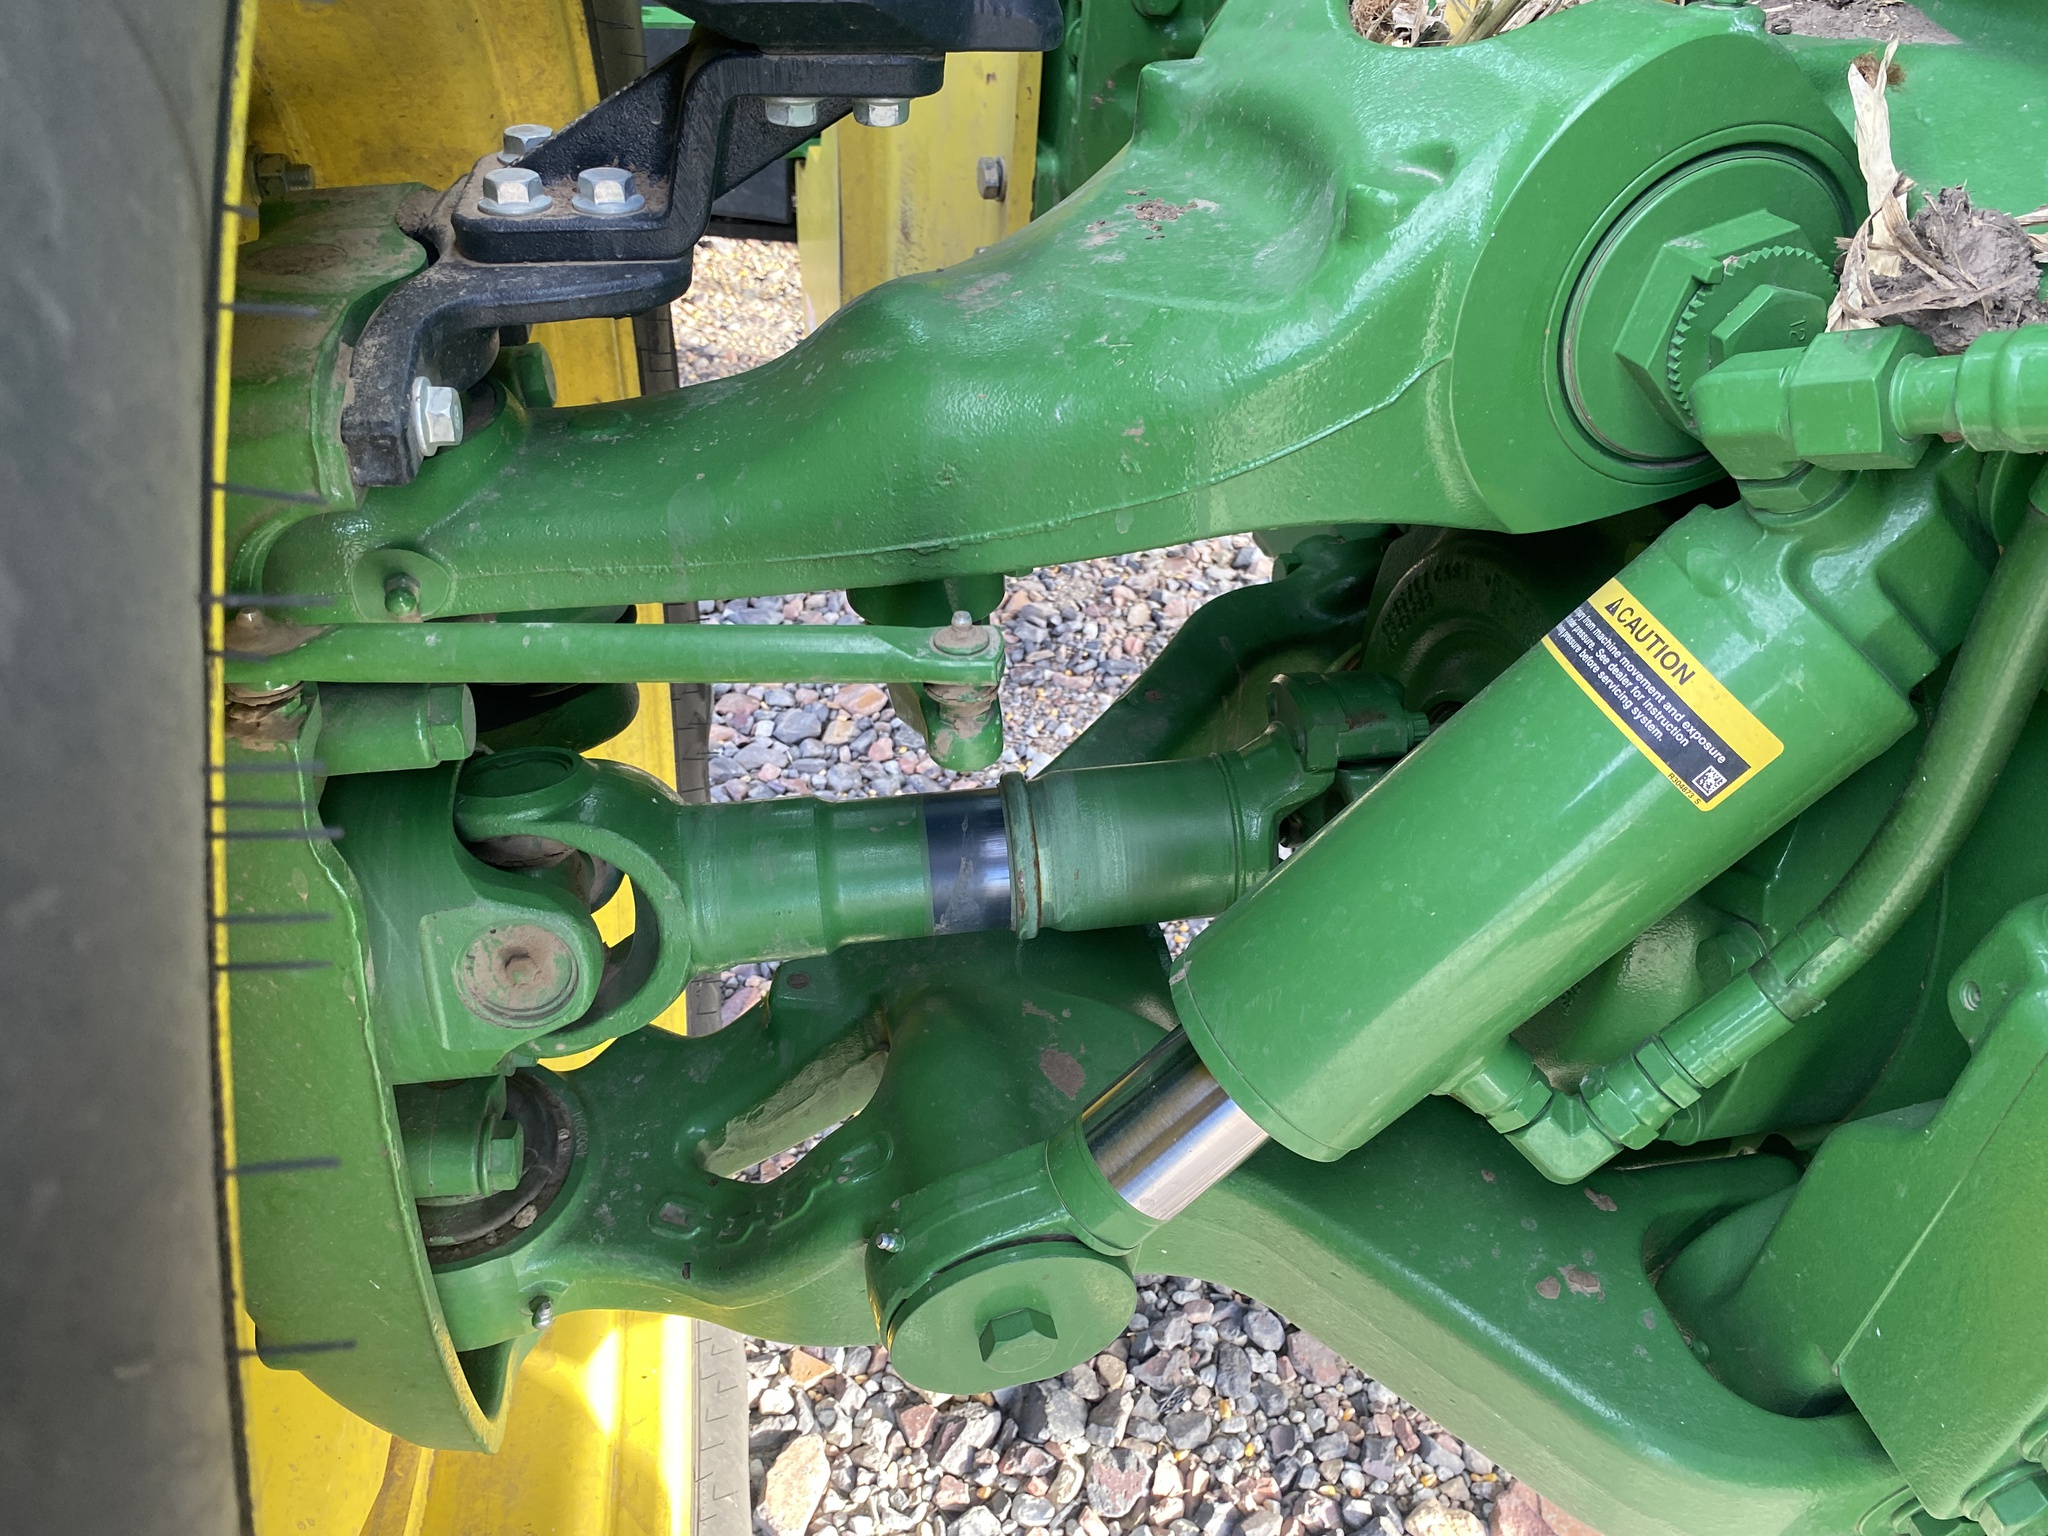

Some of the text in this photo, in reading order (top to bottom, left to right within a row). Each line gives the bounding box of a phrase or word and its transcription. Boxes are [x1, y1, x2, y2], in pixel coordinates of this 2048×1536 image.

[1560, 630, 1582, 653] pressure
[1578, 648, 1600, 673] before
[1597, 670, 1633, 709] servicing
[1631, 706, 1664, 742] system.
[1571, 625, 1596, 651] pressure.
[1595, 648, 1610, 665] See
[1607, 662, 1633, 688] dealer
[1630, 685, 1646, 701] for
[1642, 698, 1689, 747] instruction
[1582, 615, 1597, 631] from
[1592, 628, 1622, 658] machine
[1619, 656, 1666, 704] movement
[1662, 701, 1686, 723] and
[1682, 721, 1726, 764] exposure
[1616, 606, 1696, 686] CAUTION
